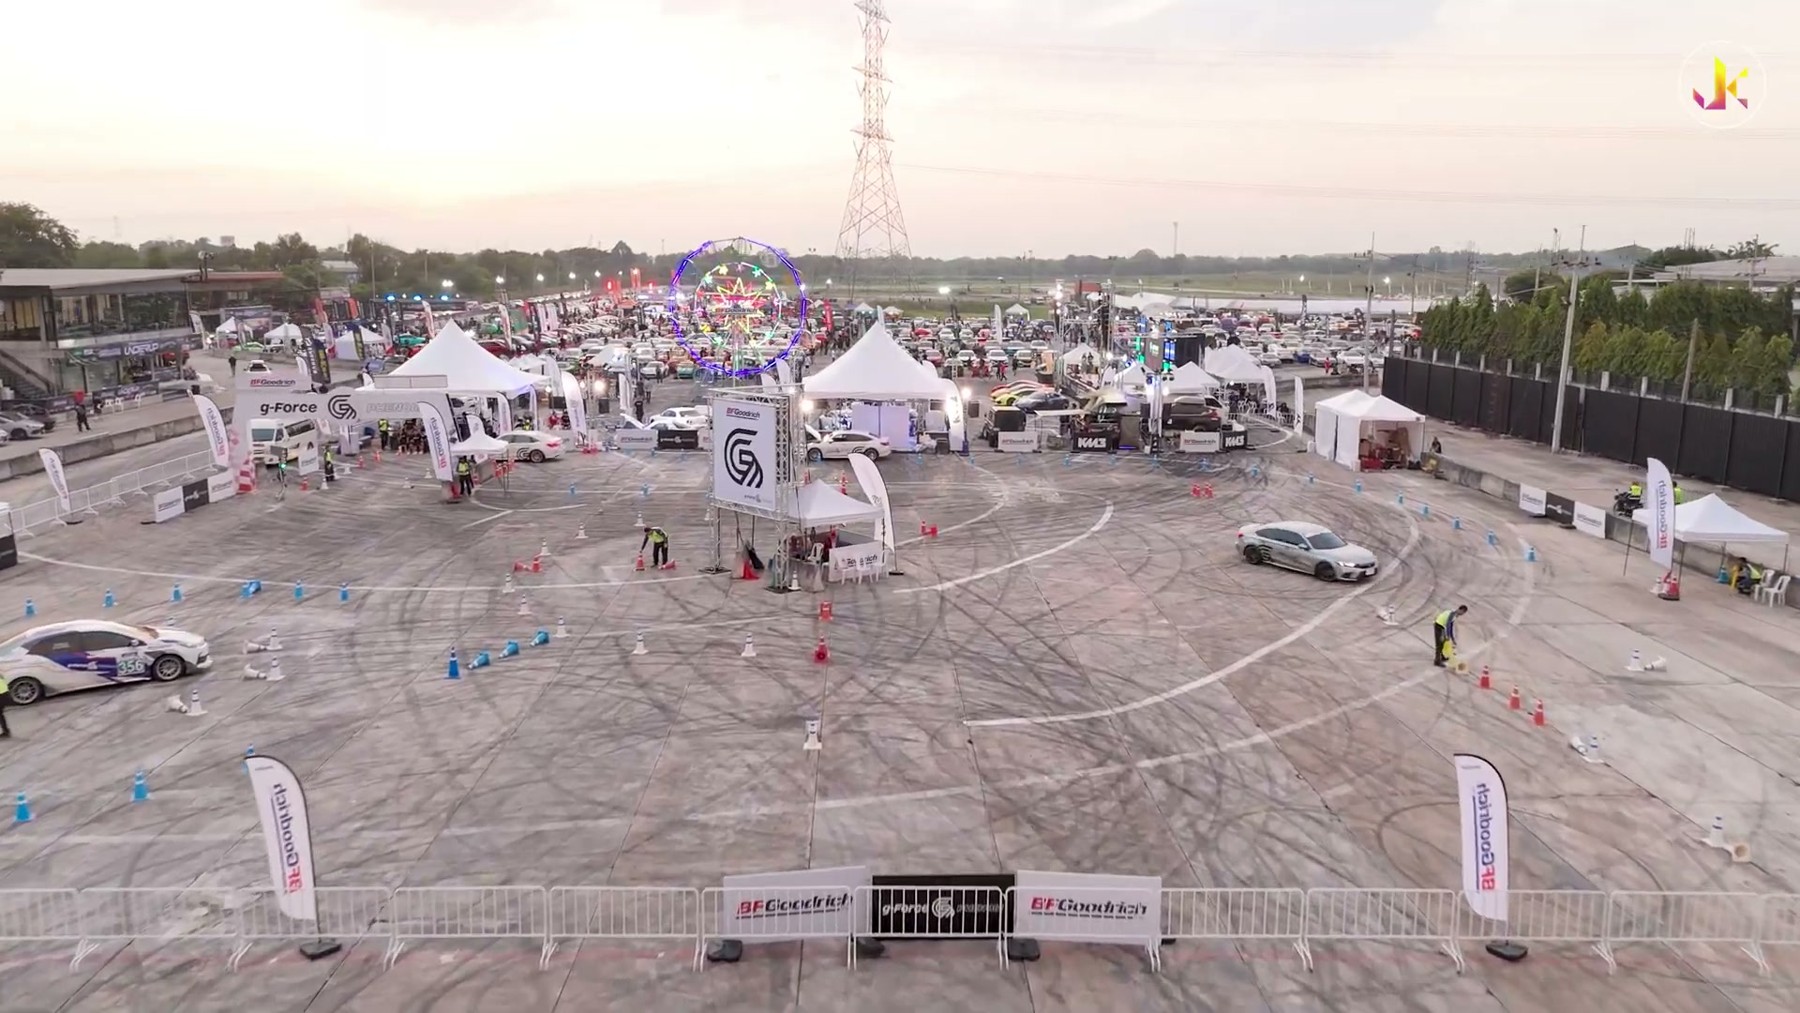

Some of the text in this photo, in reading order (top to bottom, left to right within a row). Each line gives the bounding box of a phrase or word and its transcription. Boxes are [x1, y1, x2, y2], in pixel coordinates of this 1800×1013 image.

[250, 378, 296, 386] BFGoodrich
[260, 402, 318, 415] g-Force
[726, 407, 761, 419] BFGoodrich
[118, 660, 144, 673] 356
[736, 893, 853, 915] BFGoodrich
[1030, 897, 1147, 915] BFGoodrich
